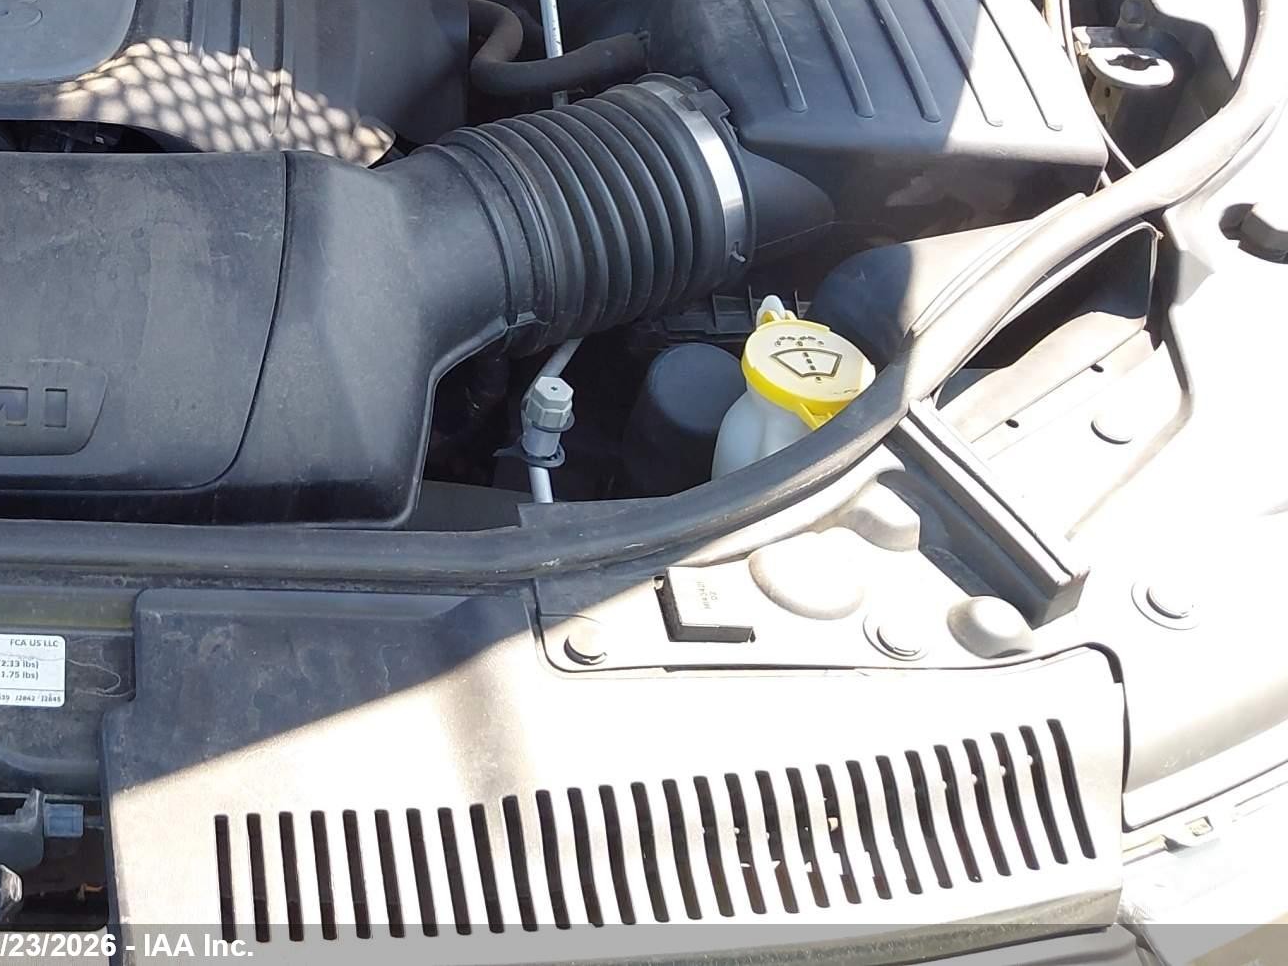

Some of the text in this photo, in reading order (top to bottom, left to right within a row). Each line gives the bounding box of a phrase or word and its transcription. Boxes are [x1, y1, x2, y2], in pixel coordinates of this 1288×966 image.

[10, 638, 59, 648] FCA US LLC
[23, 660, 39, 670] lbs)
[23, 671, 39, 681] lbs)
